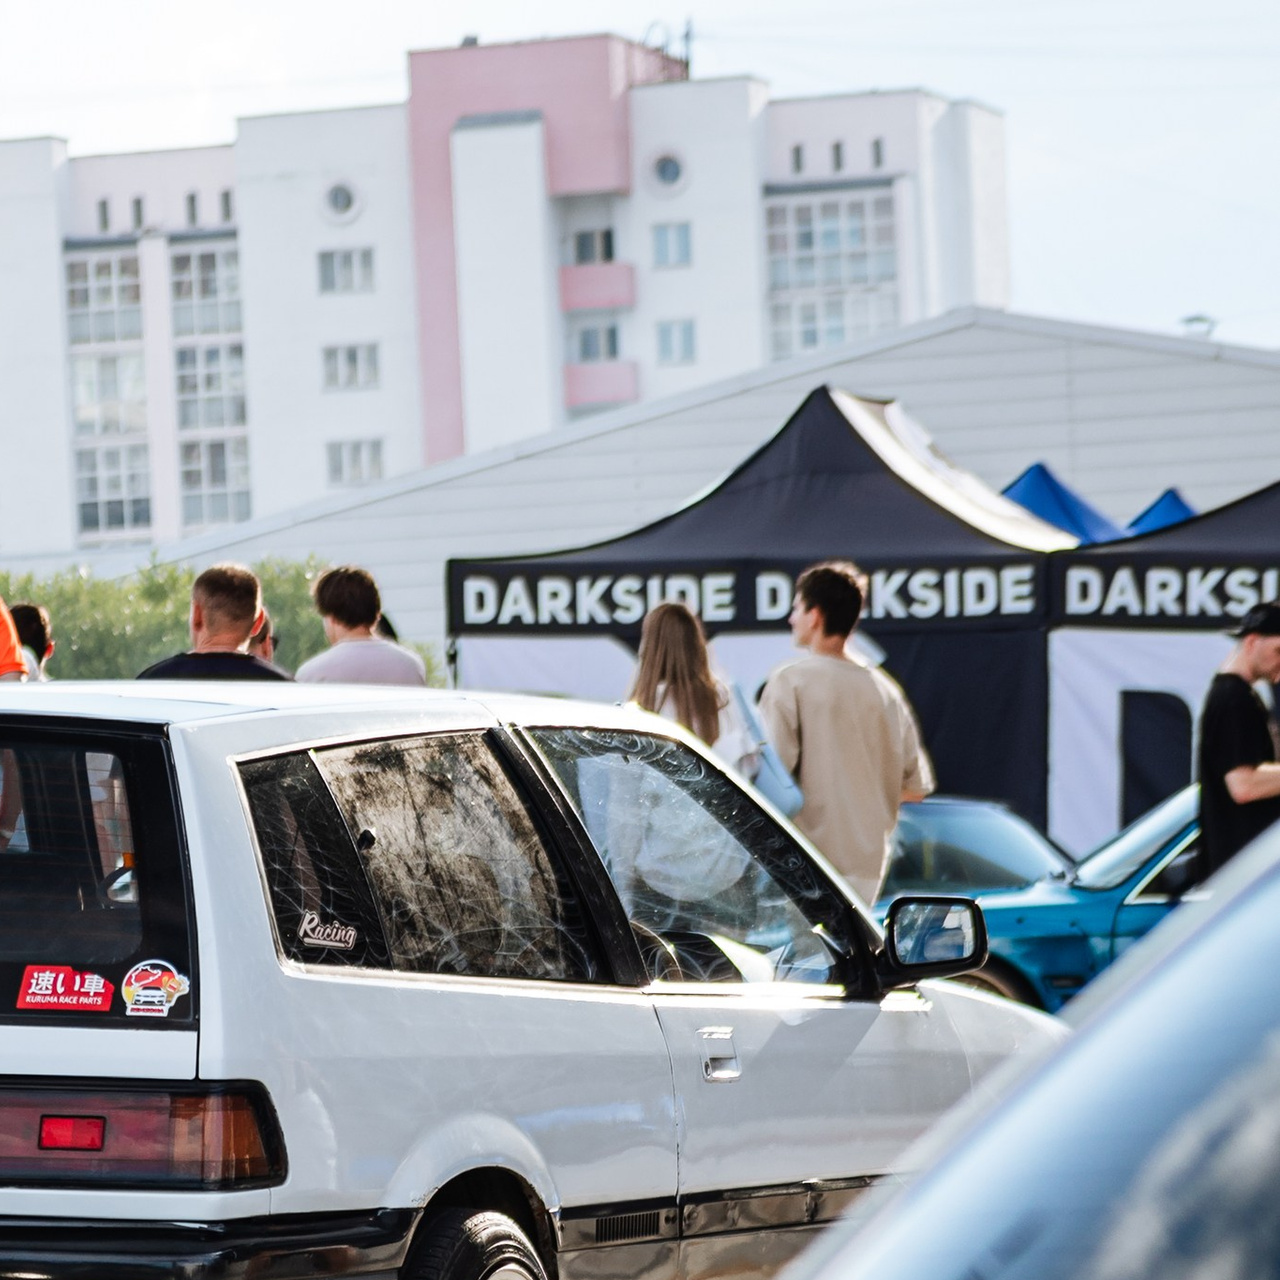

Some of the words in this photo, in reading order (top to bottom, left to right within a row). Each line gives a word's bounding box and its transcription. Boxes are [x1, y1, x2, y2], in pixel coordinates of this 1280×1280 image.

[755, 564, 1037, 623] DKSIDE
[299, 911, 356, 947] Racing
[28, 970, 105, 997] 速い車
[25, 995, 58, 1004] KURUMA
[59, 996, 78, 1005] RACE
[79, 996, 102, 1005] PARTS
